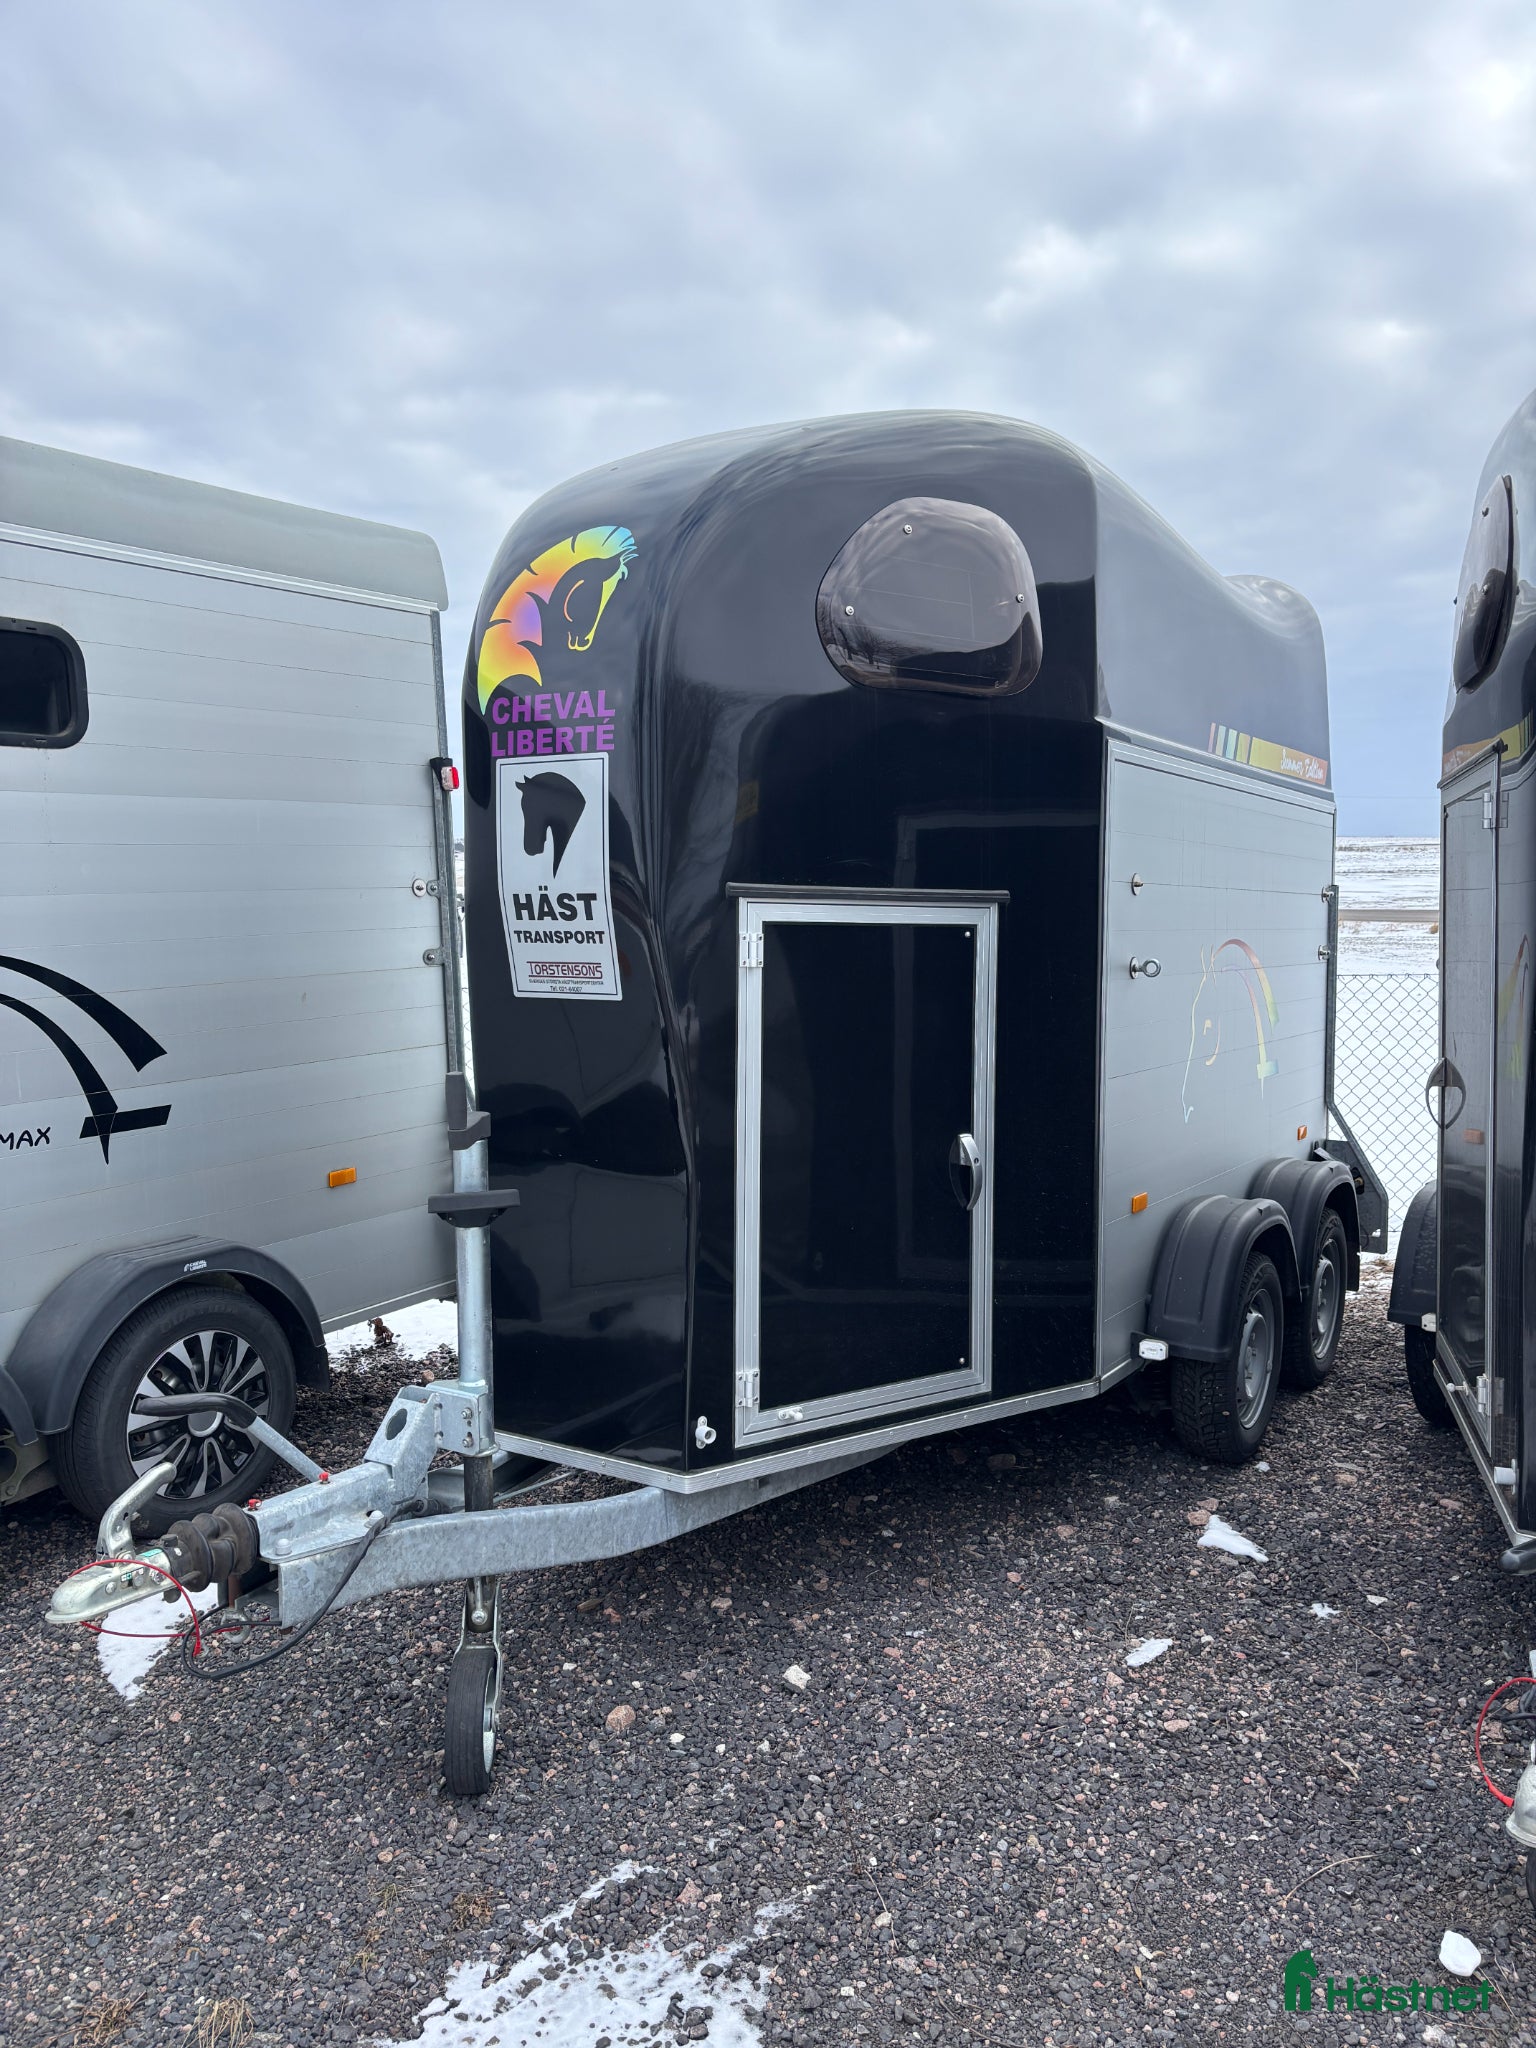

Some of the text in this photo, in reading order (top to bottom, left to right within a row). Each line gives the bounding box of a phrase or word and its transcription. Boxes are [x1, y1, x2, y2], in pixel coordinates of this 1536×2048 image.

[492, 689, 615, 725] CHEVAL
[491, 718, 615, 757] LIBERTÉ
[513, 885, 597, 921] HÄST
[513, 930, 605, 945] TRANSPORT
[528, 962, 603, 979] TORSTENSONS
